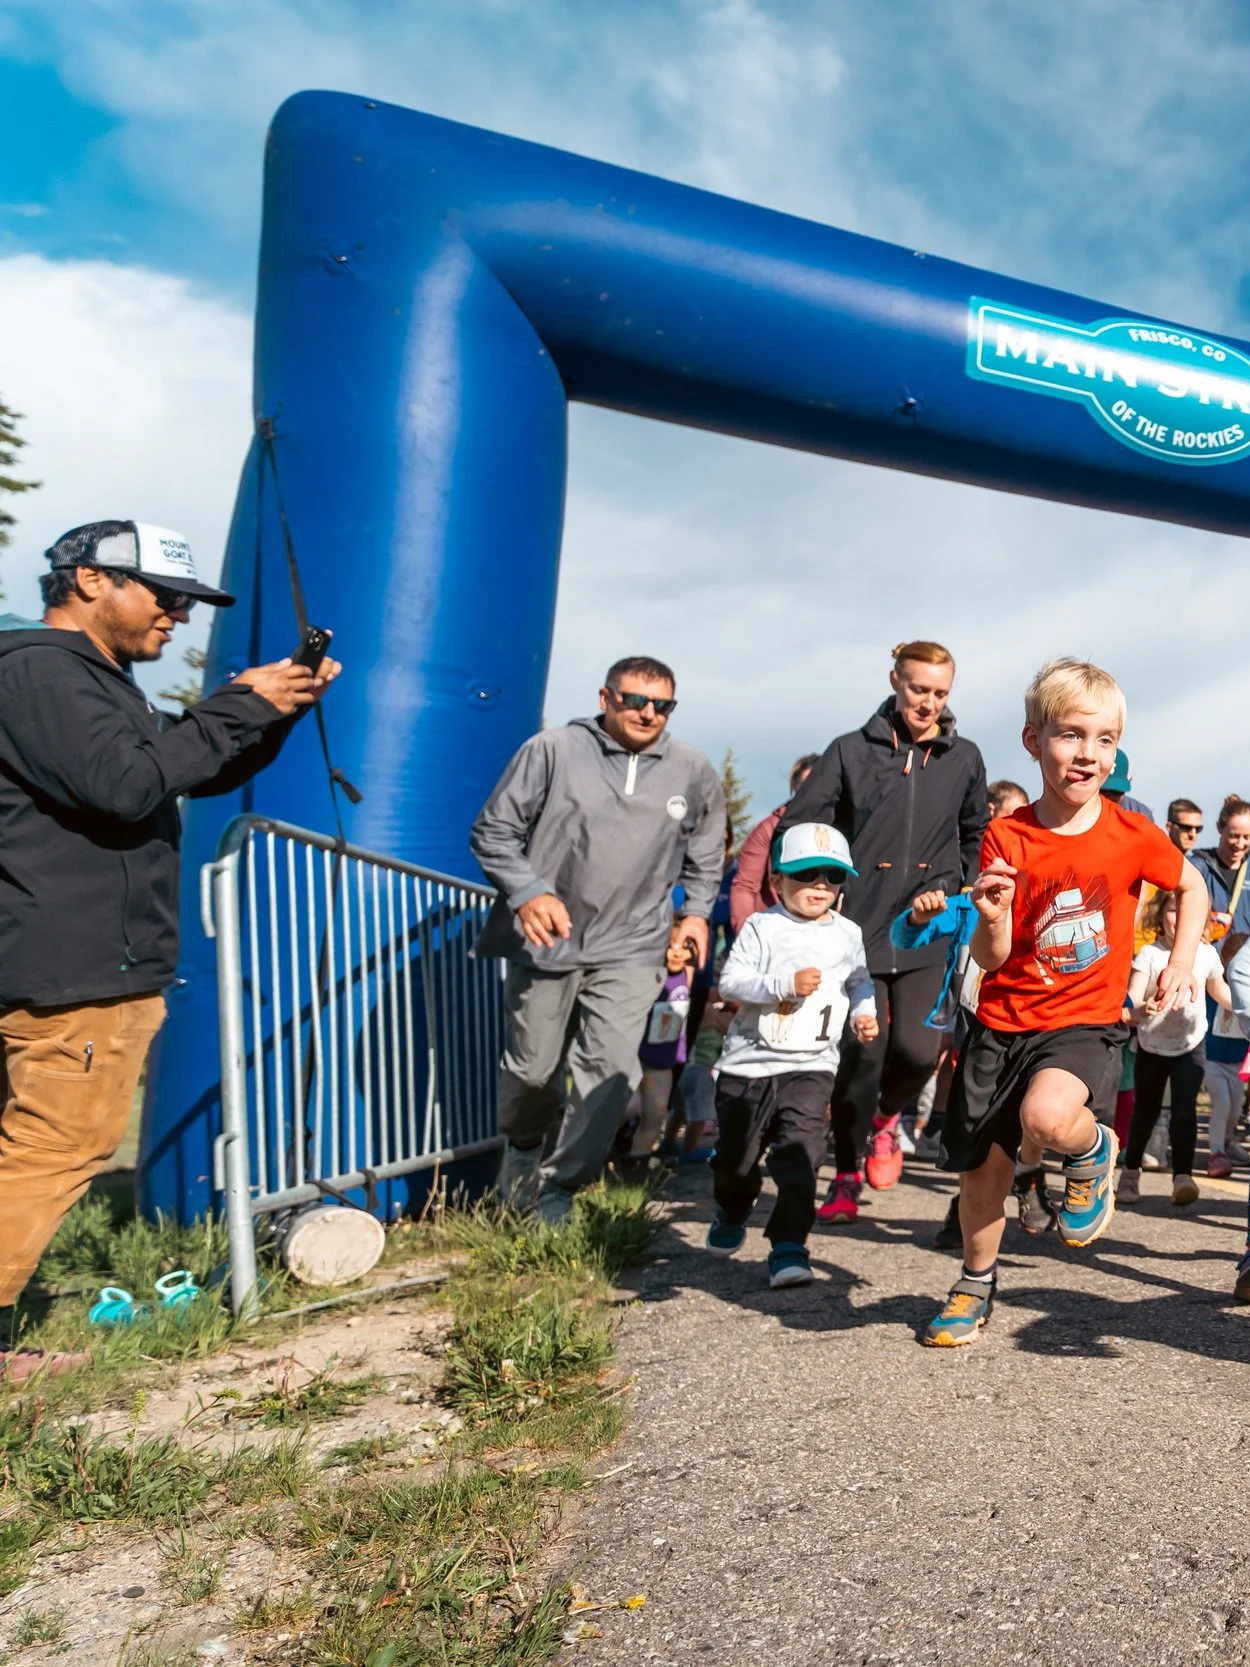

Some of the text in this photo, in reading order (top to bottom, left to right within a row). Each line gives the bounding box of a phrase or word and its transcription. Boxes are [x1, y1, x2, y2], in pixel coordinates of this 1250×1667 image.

[995, 324, 1137, 389] MAIN
[1127, 328, 1227, 362] FRISCO, CO
[1111, 400, 1245, 448] OF THE ROCKIES
[815, 1004, 832, 1042] 1
